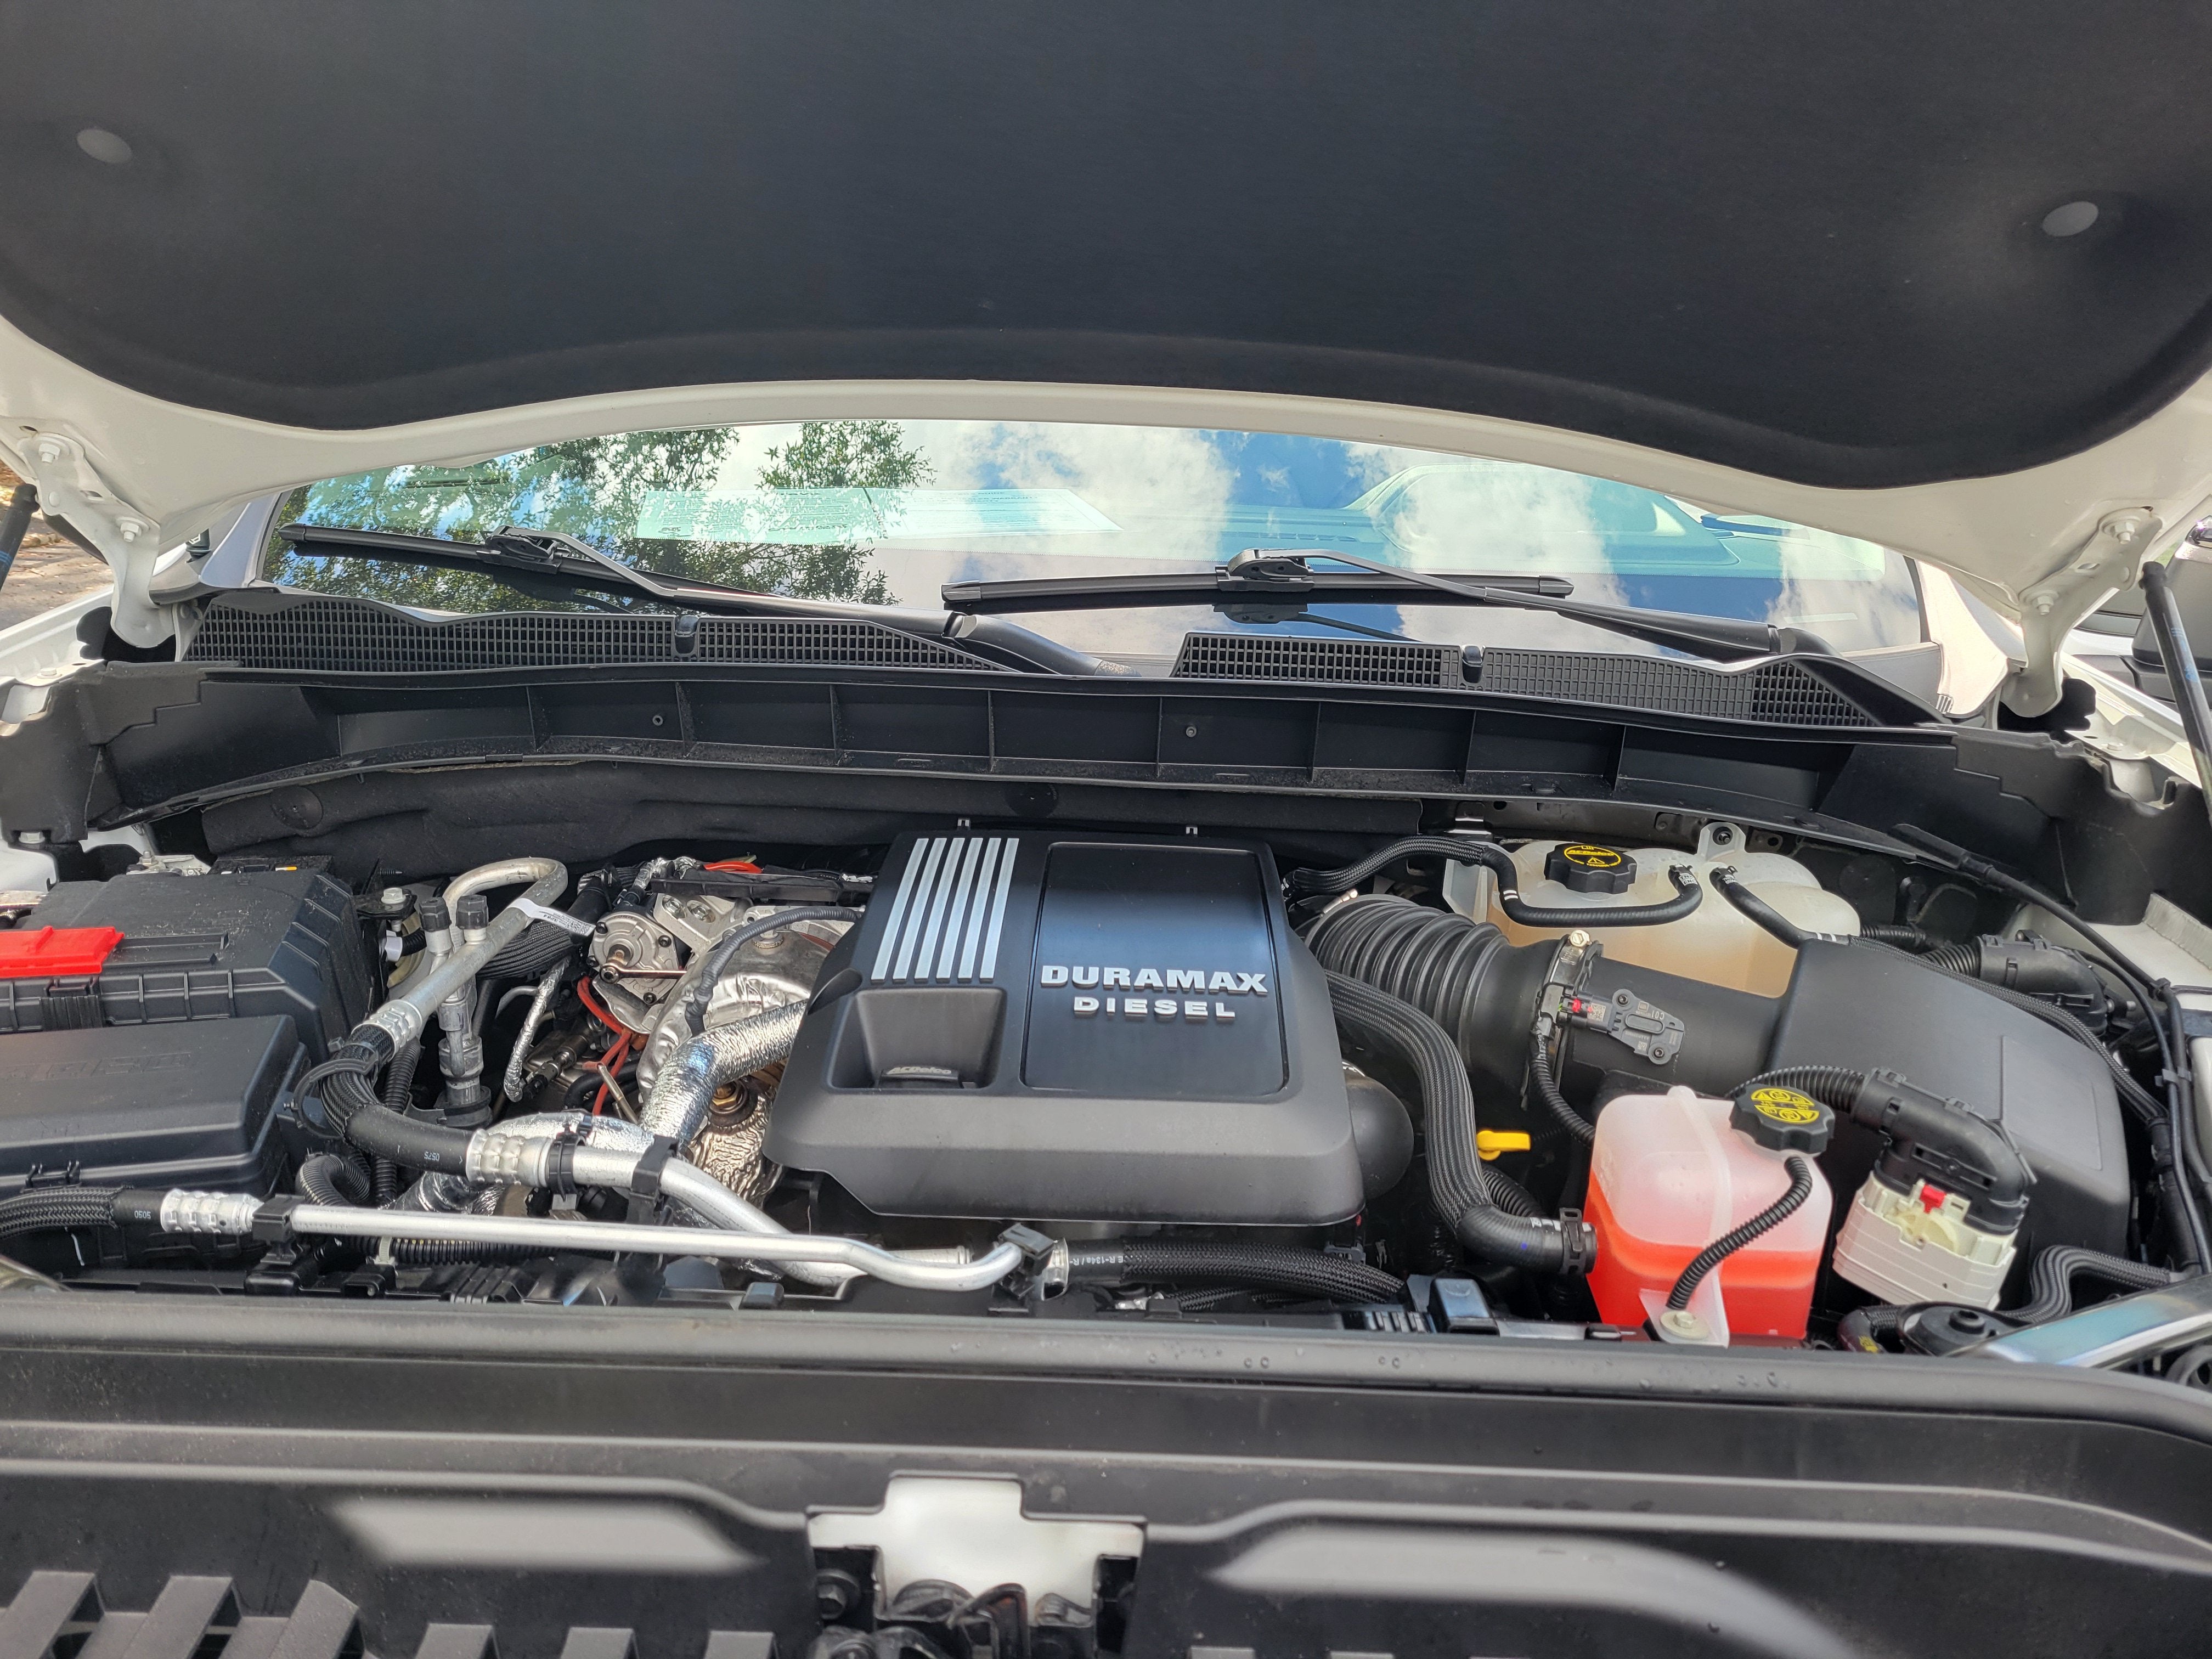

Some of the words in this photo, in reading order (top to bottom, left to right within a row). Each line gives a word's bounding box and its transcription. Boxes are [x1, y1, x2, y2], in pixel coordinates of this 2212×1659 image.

[1041, 965, 1268, 995] DURAMAX
[1073, 996, 1235, 1018] DIESEL
[134, 1210, 151, 1219] 0505
[1086, 1256, 1116, 1265] R-134a
